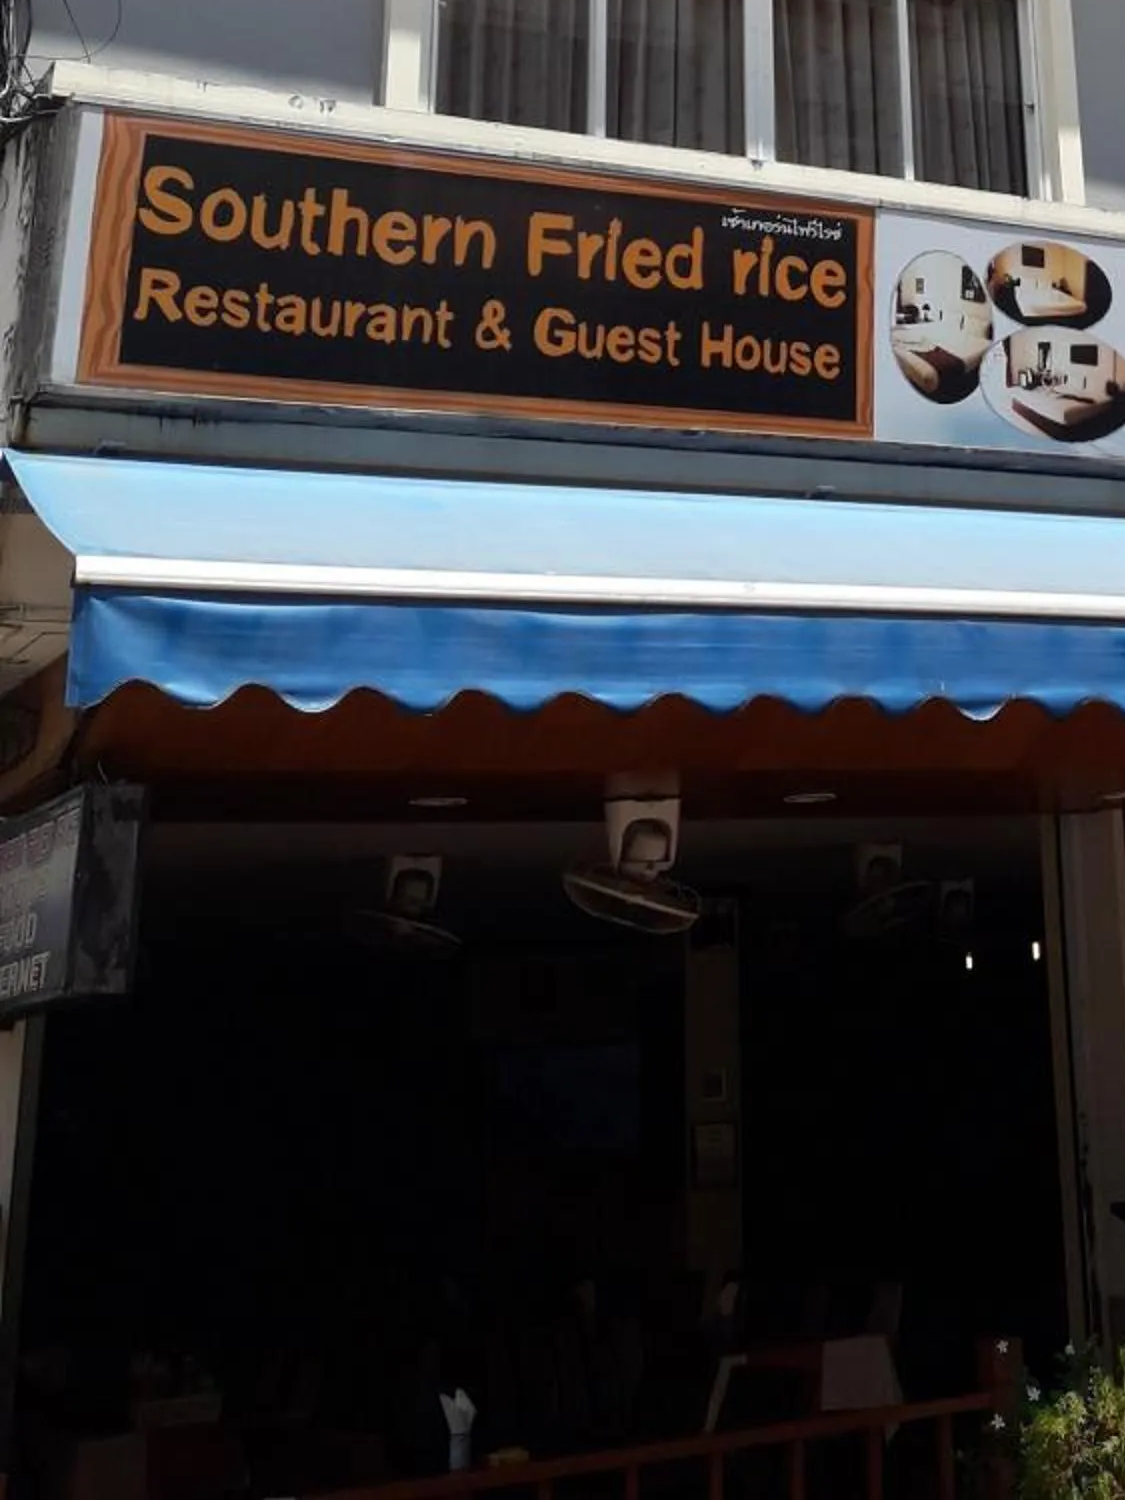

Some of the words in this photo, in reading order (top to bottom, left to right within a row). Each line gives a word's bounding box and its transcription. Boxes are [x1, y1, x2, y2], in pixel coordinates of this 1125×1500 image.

[138, 165, 497, 269] Southern
[527, 211, 705, 290] Fried
[732, 236, 848, 309] rice
[134, 267, 453, 349] Restaurant
[475, 299, 513, 352] &
[534, 307, 680, 367] Guest
[701, 325, 842, 380] House
